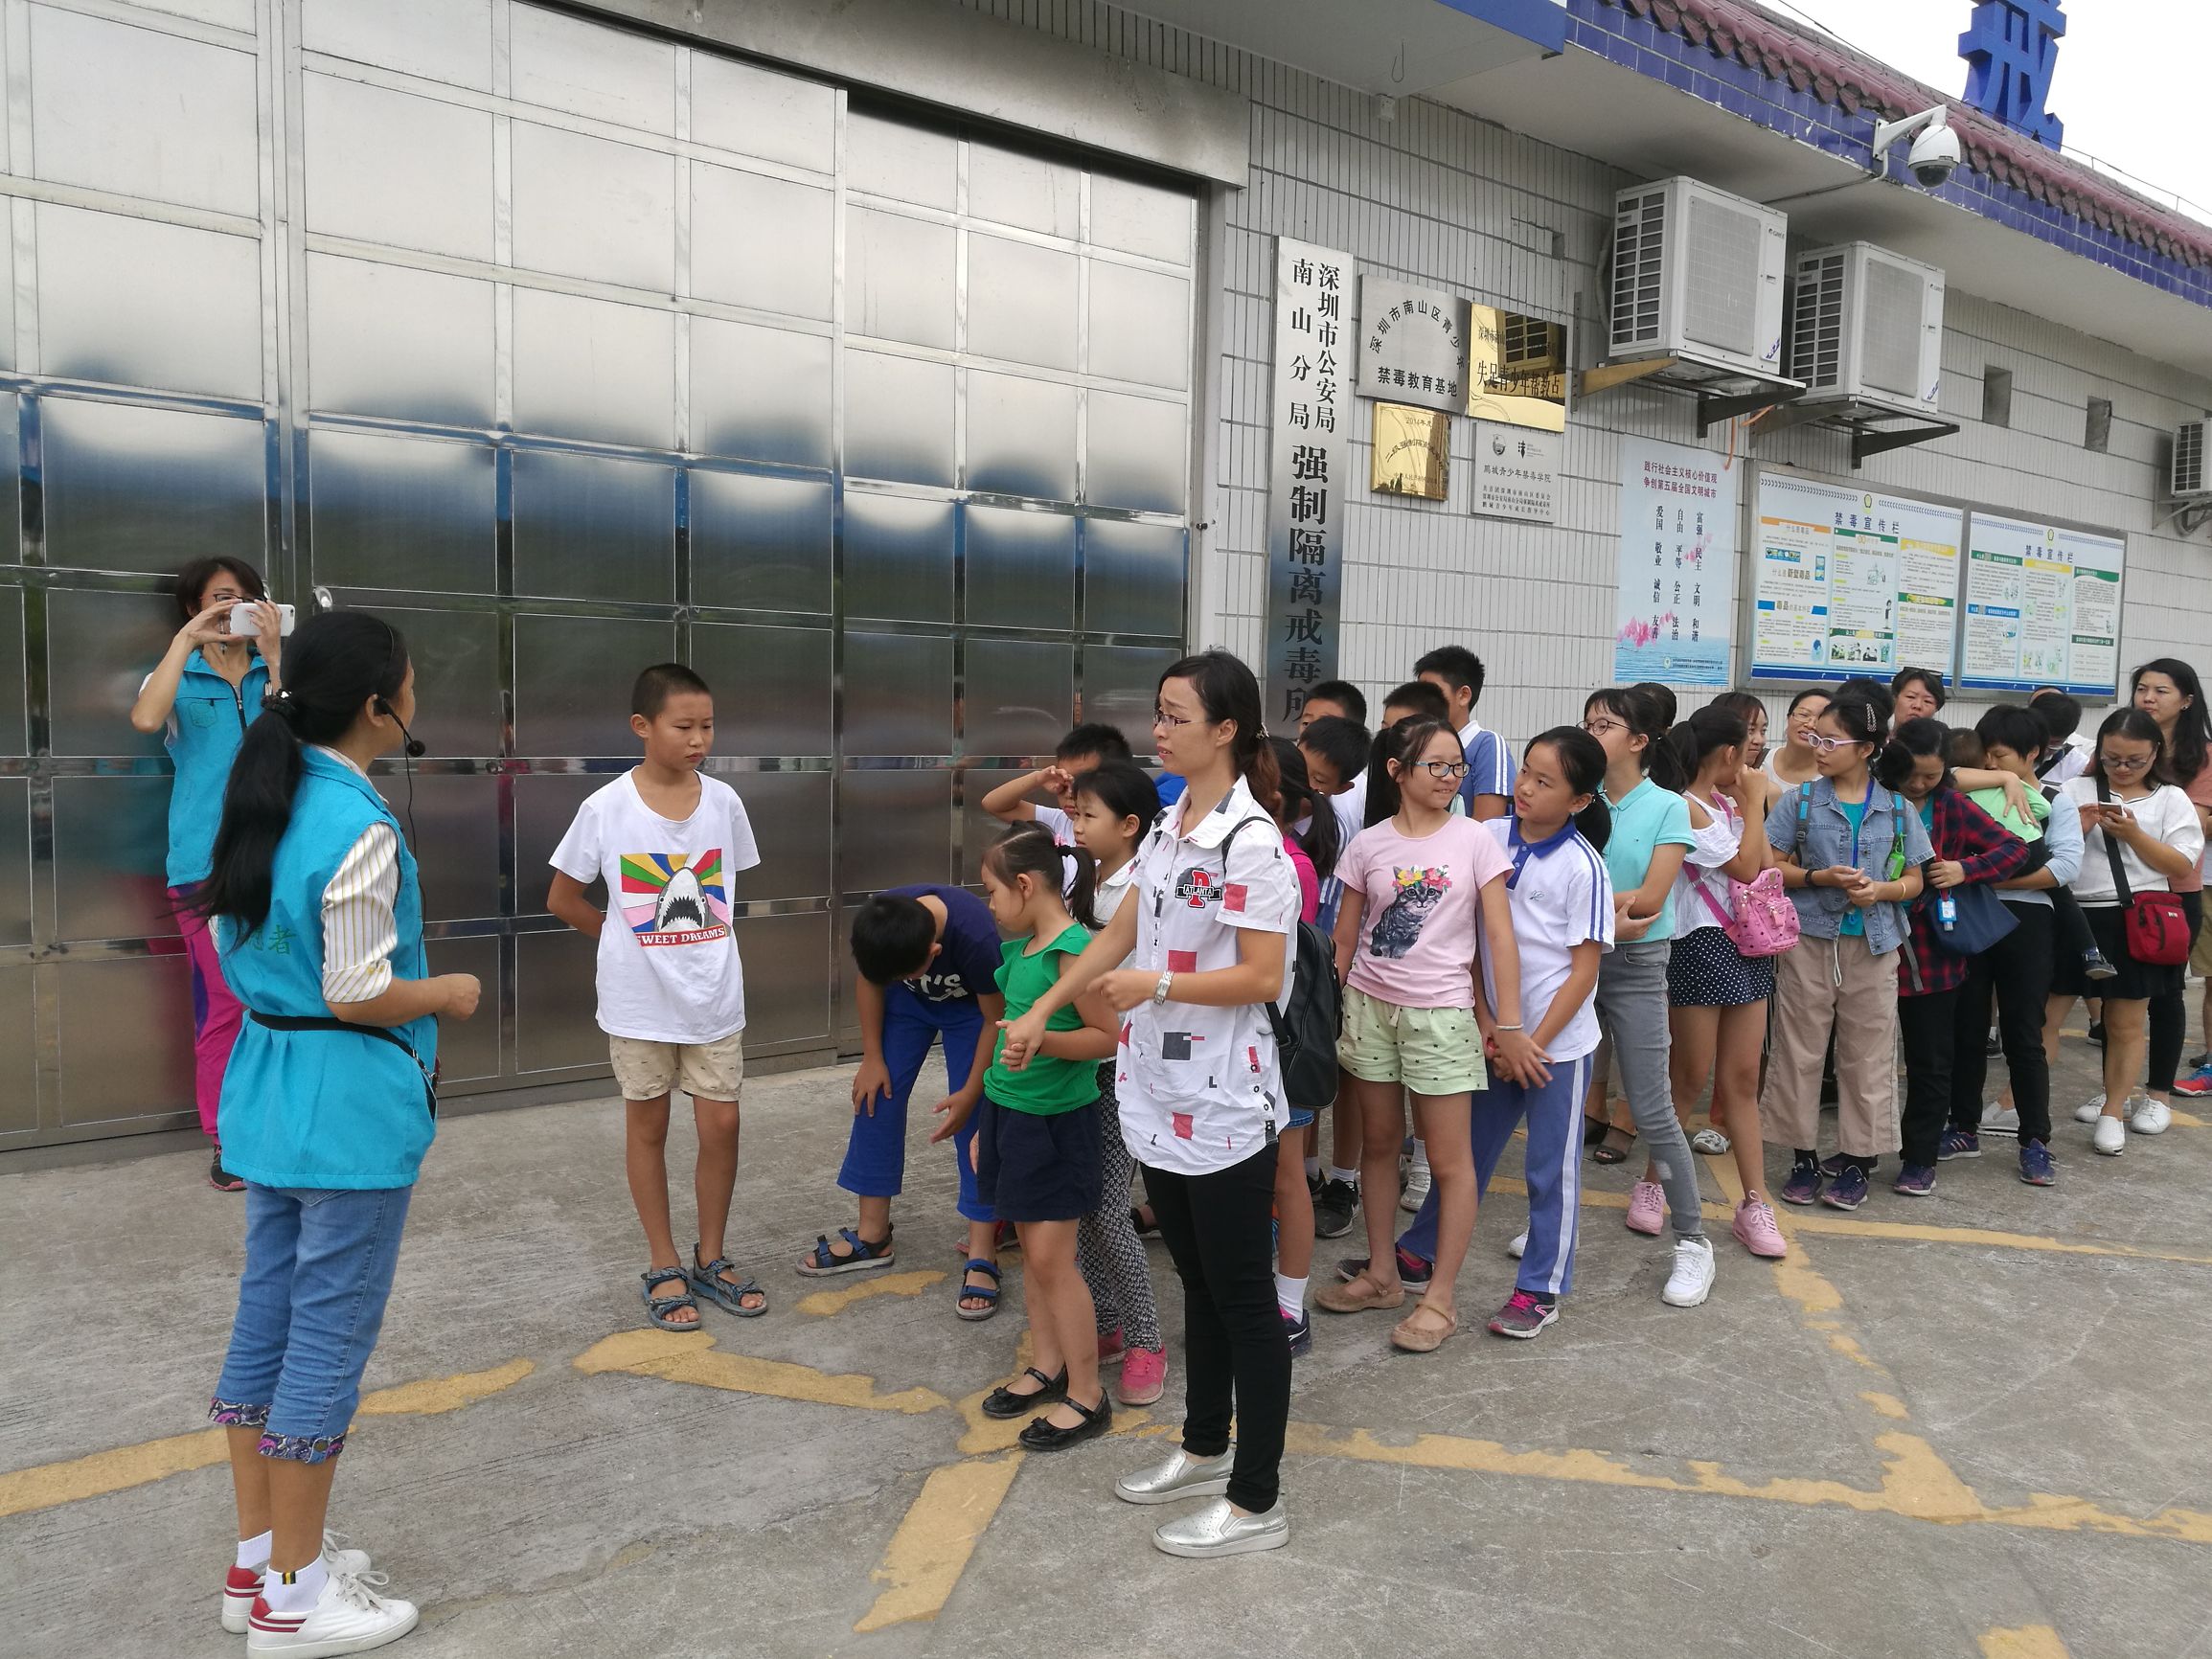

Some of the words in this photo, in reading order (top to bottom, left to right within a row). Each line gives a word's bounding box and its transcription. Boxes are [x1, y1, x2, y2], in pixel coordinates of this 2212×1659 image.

[1288, 258, 1314, 430] 南山分局
[1314, 262, 1340, 434] 深圳市公安局
[1378, 366, 1457, 398] 禁毒教育基地
[1643, 476, 1718, 499] 争创第五届全国文明城市
[1655, 505, 1664, 531] 爱国
[1693, 581, 1701, 607] 文明
[1184, 886, 1213, 896] ATLANTA
[681, 927, 726, 943] DREAMS
